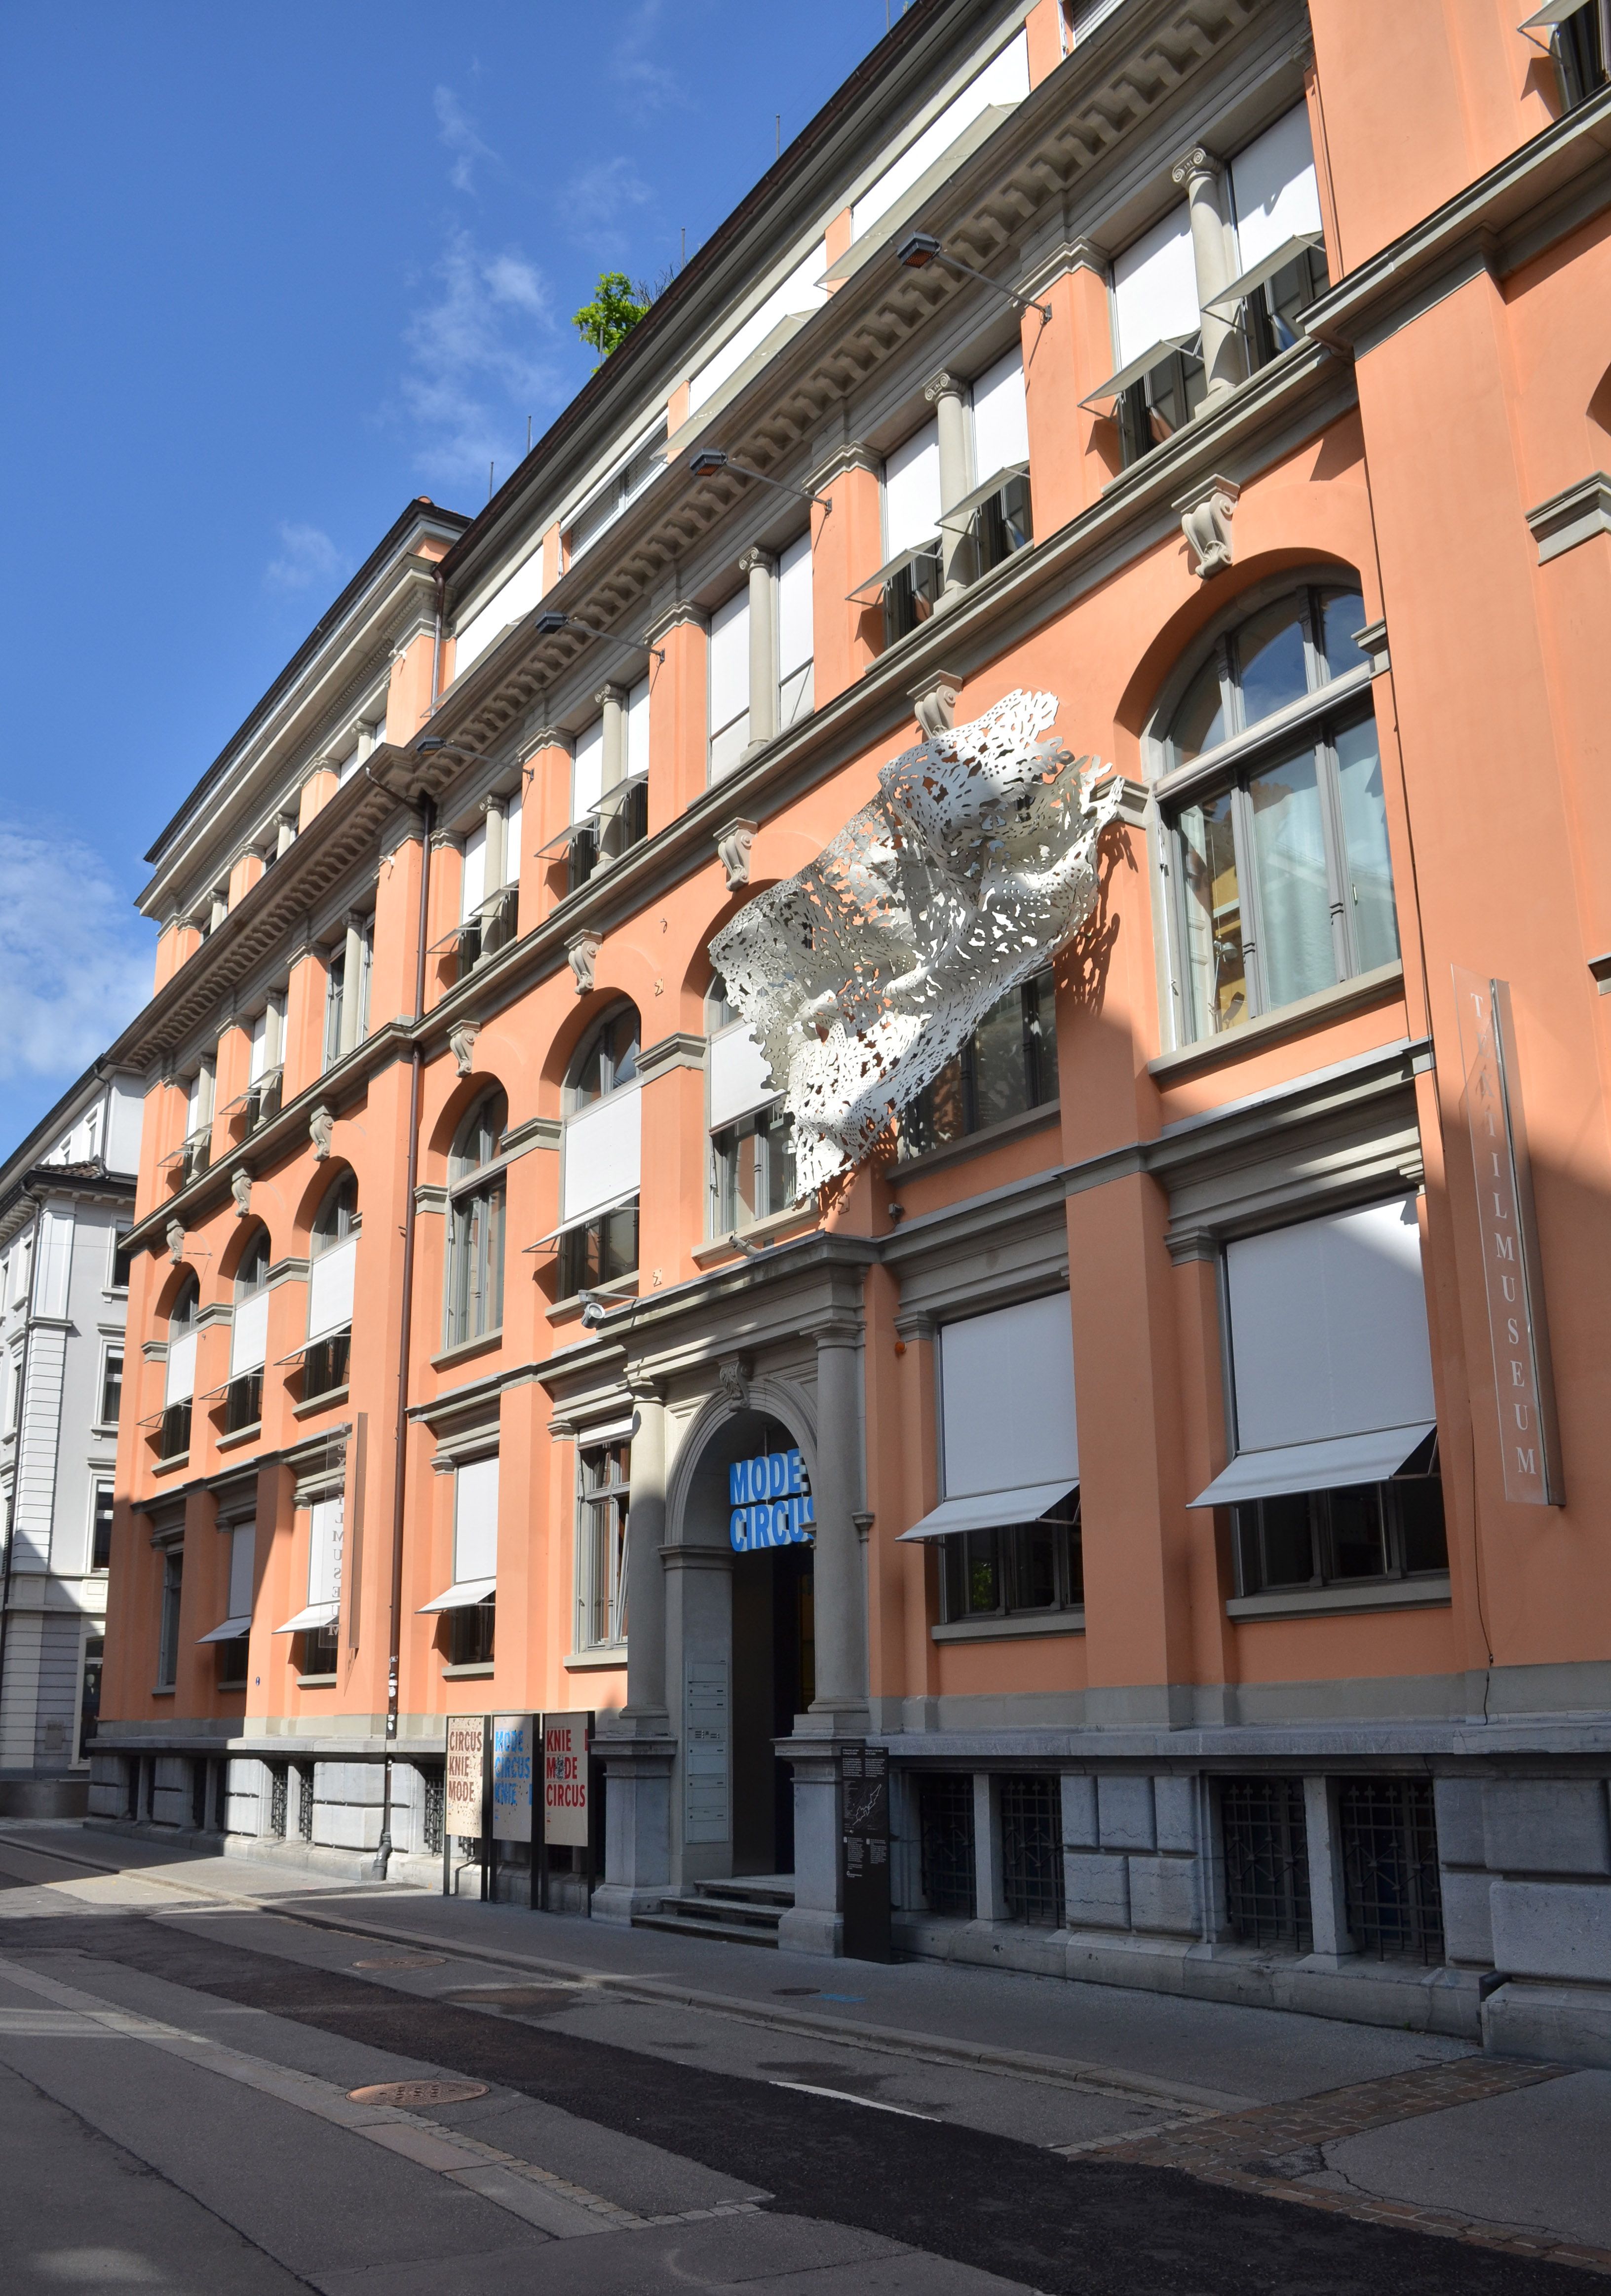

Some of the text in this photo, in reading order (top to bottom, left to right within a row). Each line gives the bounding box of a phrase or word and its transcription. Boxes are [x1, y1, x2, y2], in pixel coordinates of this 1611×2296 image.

[1471, 993, 1536, 1474] TEXTILMUSEUM
[729, 1448, 806, 1505] MODE
[450, 1731, 482, 1752] CIRCUS
[495, 1730, 524, 1752] MODE
[546, 1729, 572, 1752] KNIE
[449, 1756, 469, 1777] KNIE
[495, 1757, 530, 1779] CIRCUS
[448, 1780, 475, 1802] MODE
[495, 1783, 517, 1804] KNIE
[546, 1784, 586, 1807] CIRCUS
